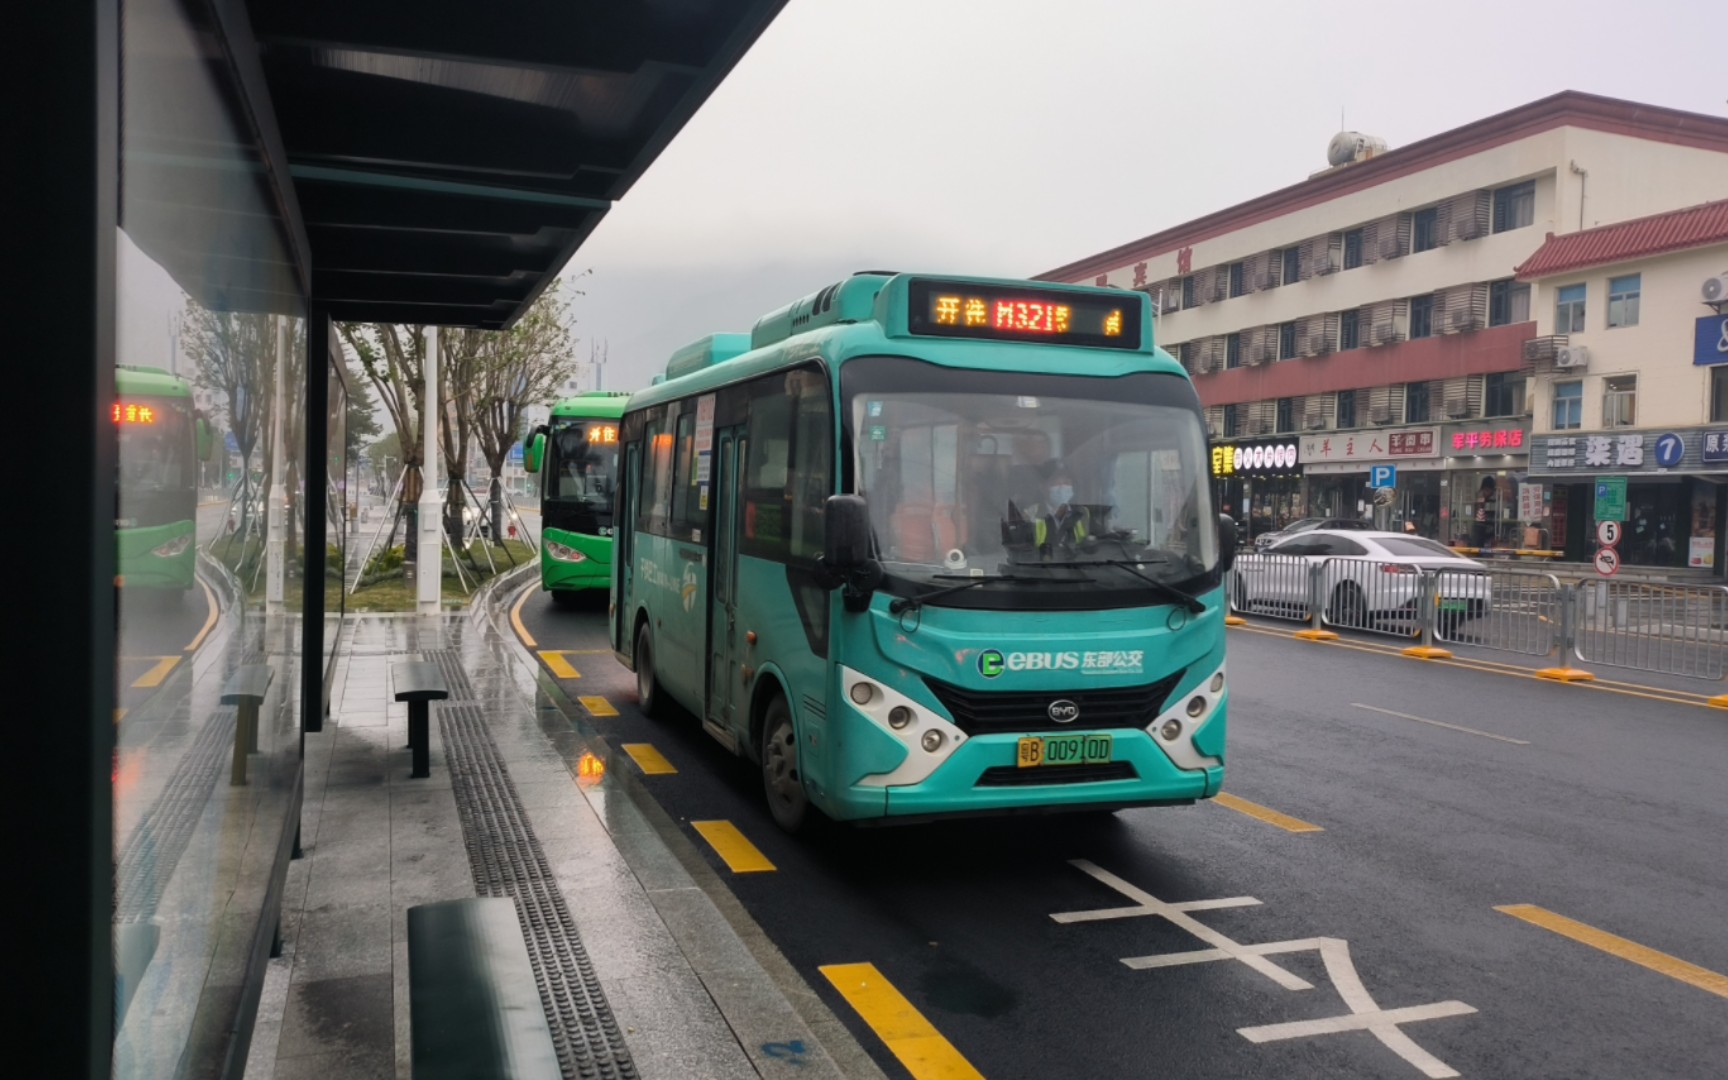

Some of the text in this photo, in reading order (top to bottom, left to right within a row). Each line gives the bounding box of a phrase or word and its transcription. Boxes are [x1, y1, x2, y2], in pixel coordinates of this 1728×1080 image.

[1320, 437, 1384, 458] 羊主人
[1376, 467, 1390, 486] P
[1607, 524, 1615, 540] 5
[1082, 650, 1143, 668] 东部公交
